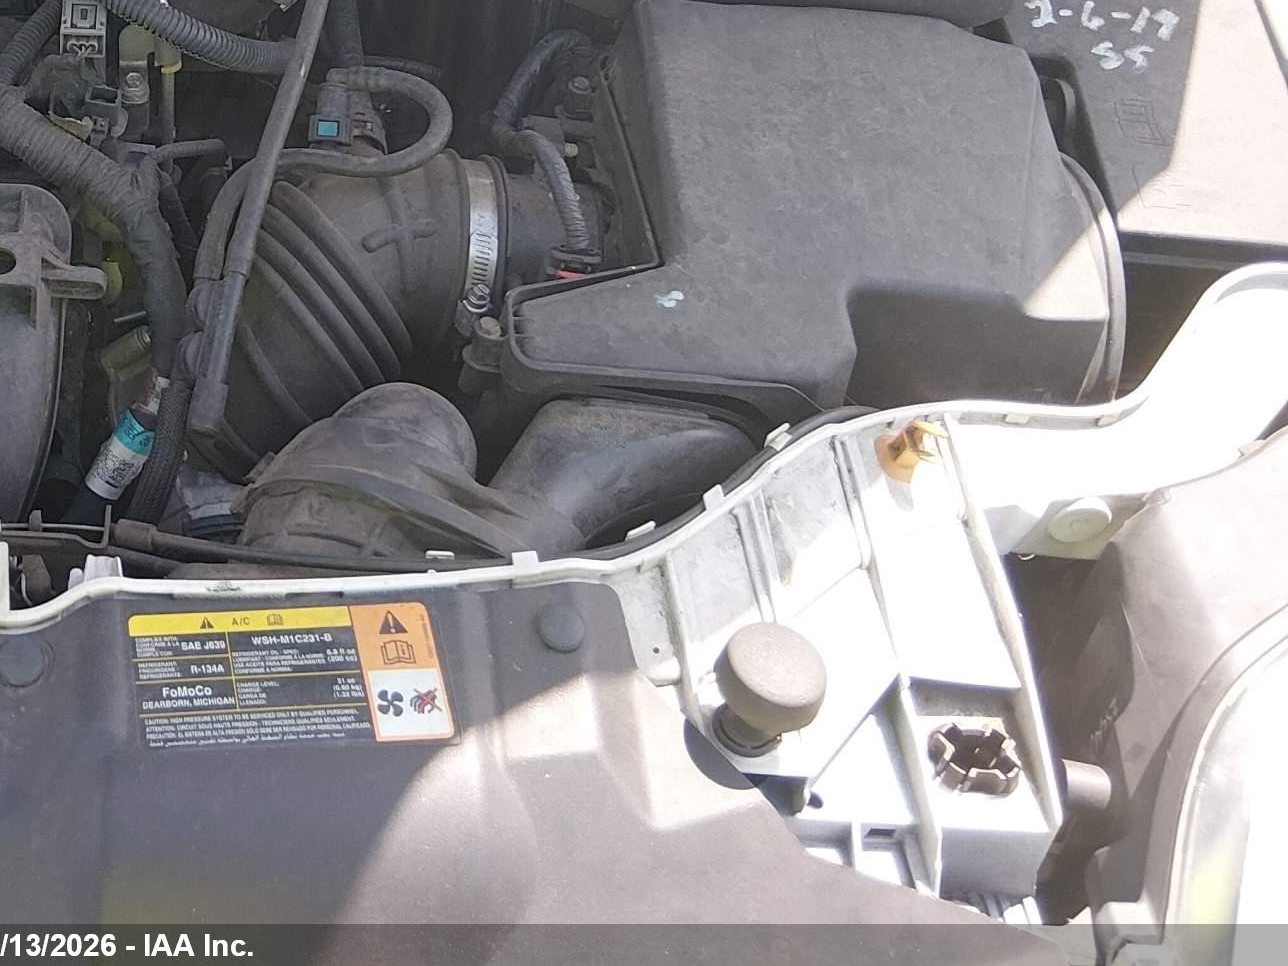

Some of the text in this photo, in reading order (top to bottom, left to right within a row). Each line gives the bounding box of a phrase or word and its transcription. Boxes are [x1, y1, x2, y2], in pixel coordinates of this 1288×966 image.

[232, 616, 250, 626] A/C
[251, 633, 332, 644] WSH-M1C231-B
[180, 640, 226, 650] SAE J639
[190, 664, 224, 674] R-134A
[162, 685, 212, 698] FoMoCo
[142, 696, 235, 710] DEARBORN, MICHIGAN
